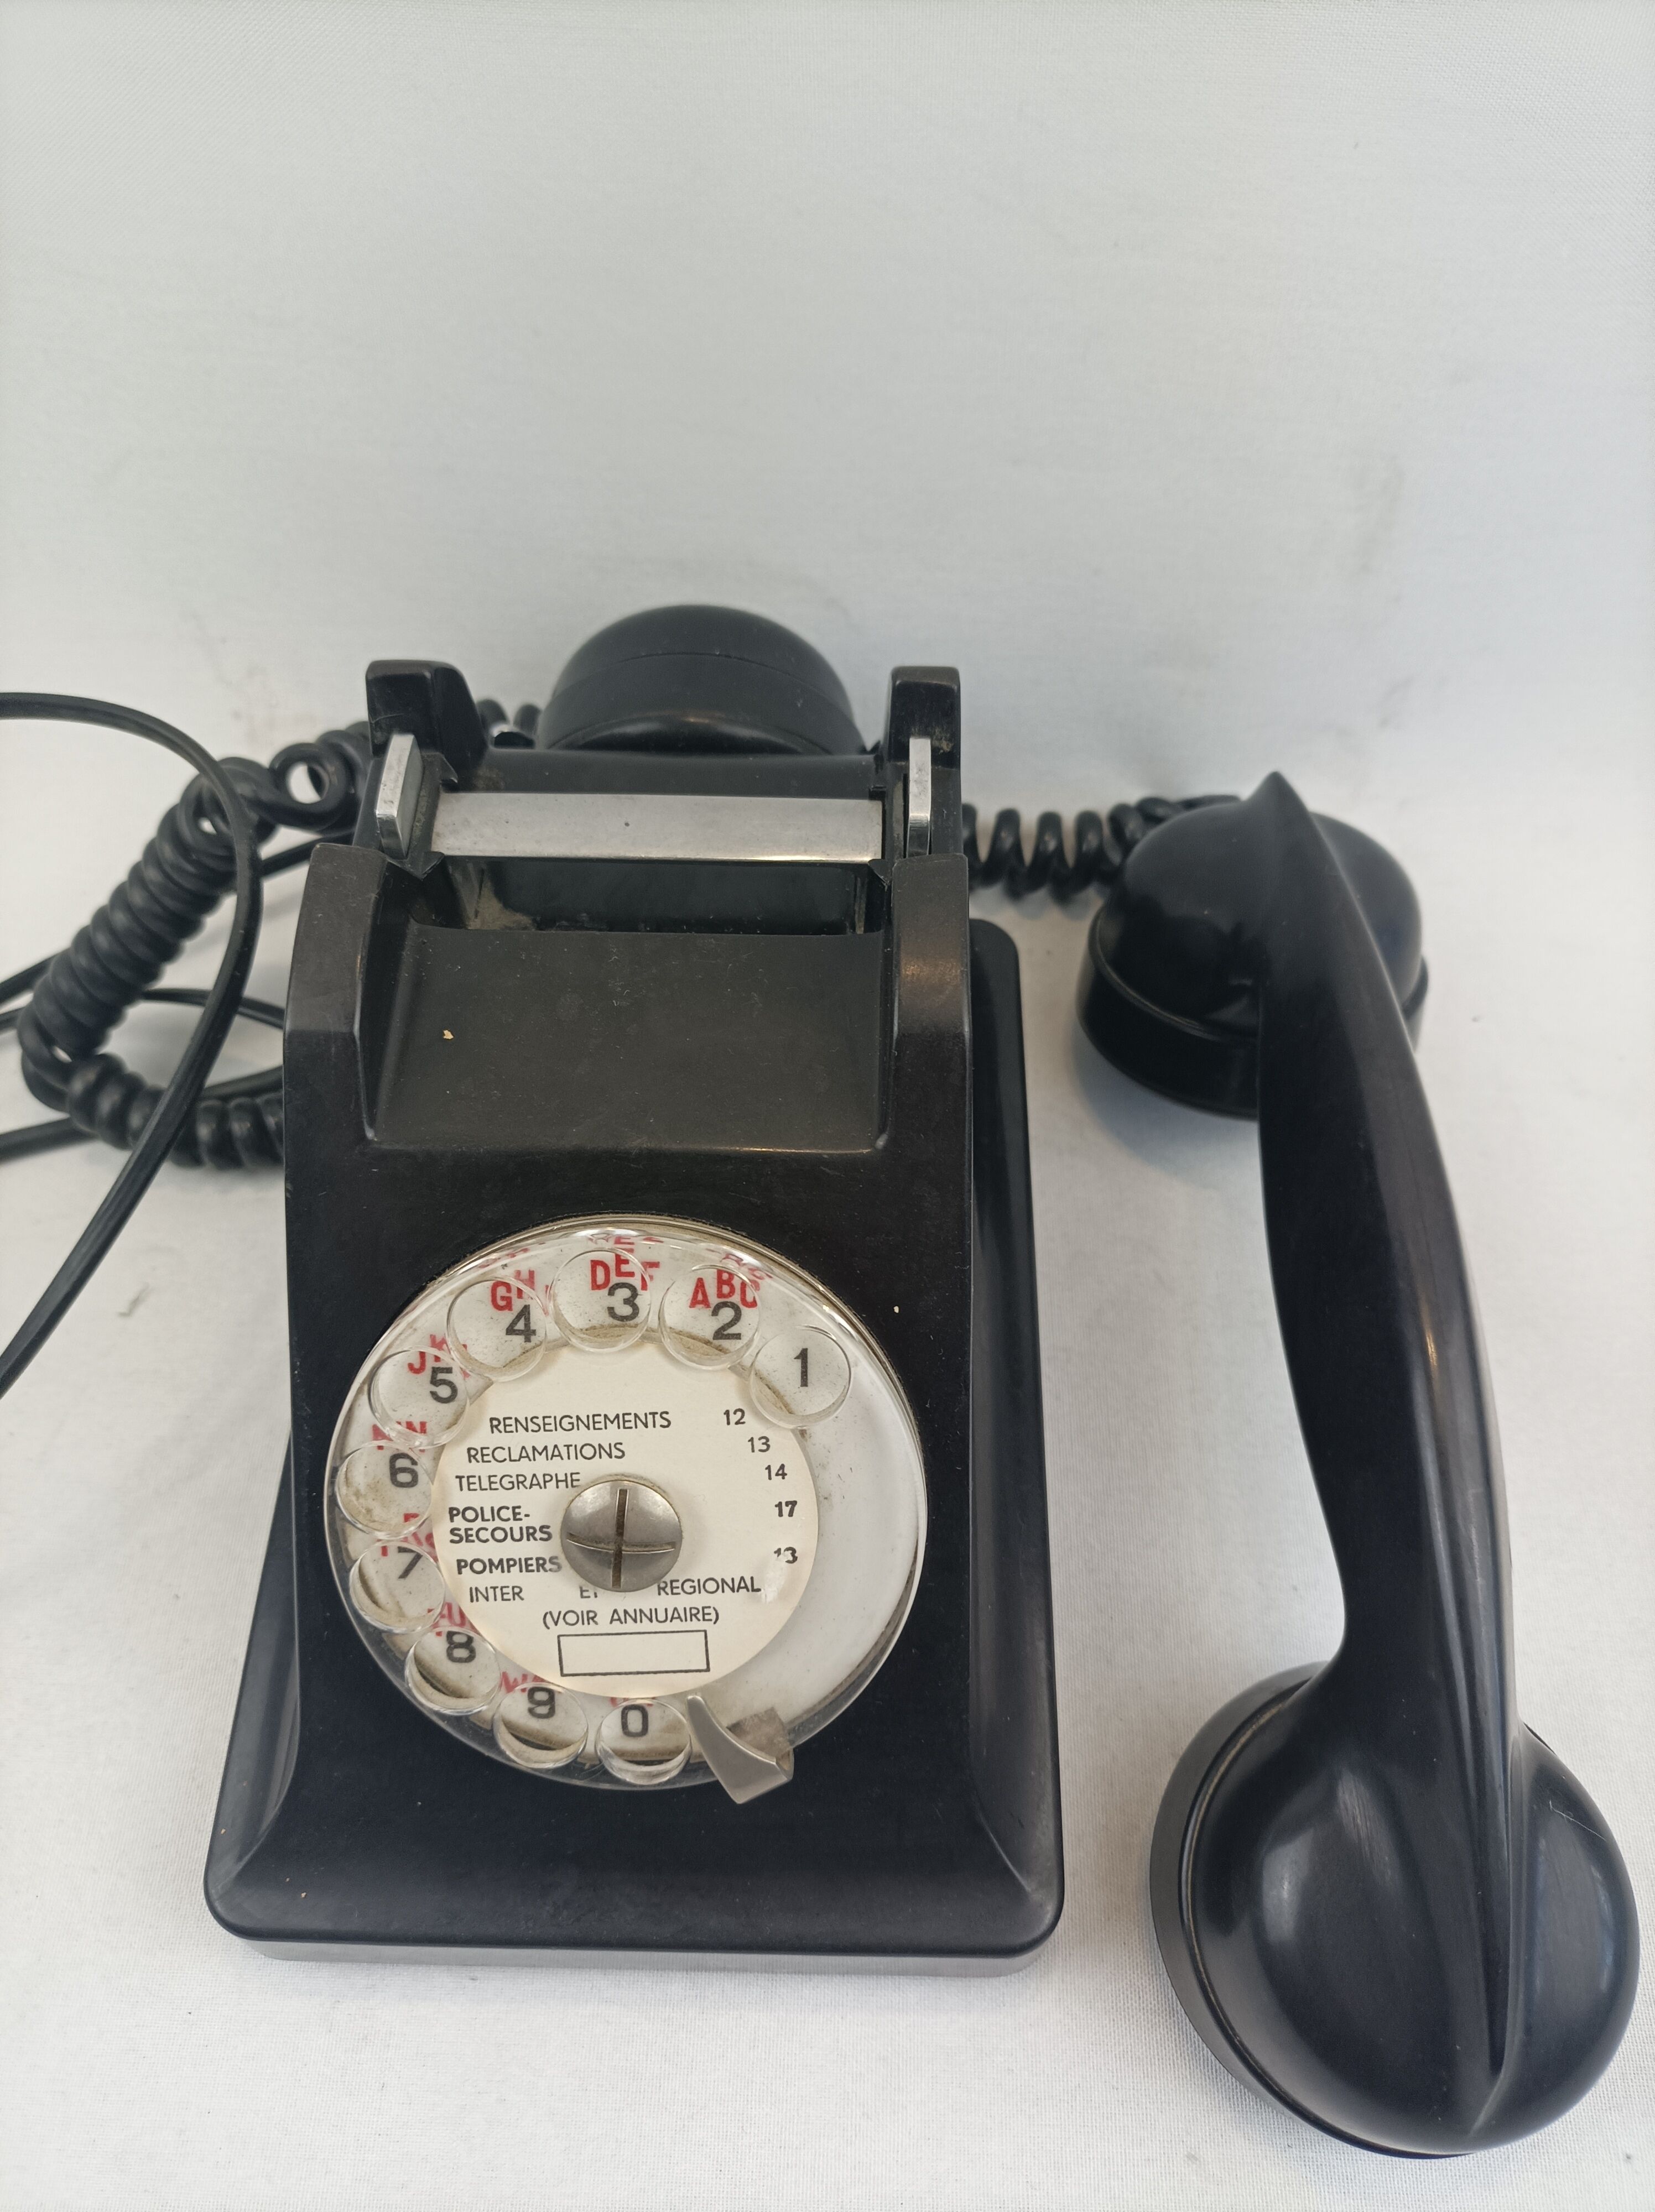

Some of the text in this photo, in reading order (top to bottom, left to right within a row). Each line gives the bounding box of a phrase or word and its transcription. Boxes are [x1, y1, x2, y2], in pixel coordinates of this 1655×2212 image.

[607, 1282, 640, 1322] 3
[689, 1267, 761, 1309] ABC
[506, 1304, 537, 1343] 4
[711, 1301, 742, 1341] 2
[793, 1348, 809, 1387] 1
[429, 1366, 458, 1404] 5
[490, 1408, 746, 1434] RENSEIGNEMENTS 12
[467, 1436, 771, 1463] RECLAMATIONS 13
[389, 1452, 419, 1488] 6
[455, 1463, 787, 1492] TELEGRAPHE 14
[449, 1505, 530, 1523] POLICE-
[449, 1500, 798, 1544] SECOURS 17
[397, 1546, 423, 1579] 7
[456, 1556, 562, 1575] POMPIERS
[469, 1585, 524, 1603] INTER
[657, 1575, 762, 1596] REGIONAL
[543, 1605, 720, 1630] (VOIR ANNUAIRE)
[446, 1630, 476, 1663] 8
[527, 1687, 555, 1719] 9
